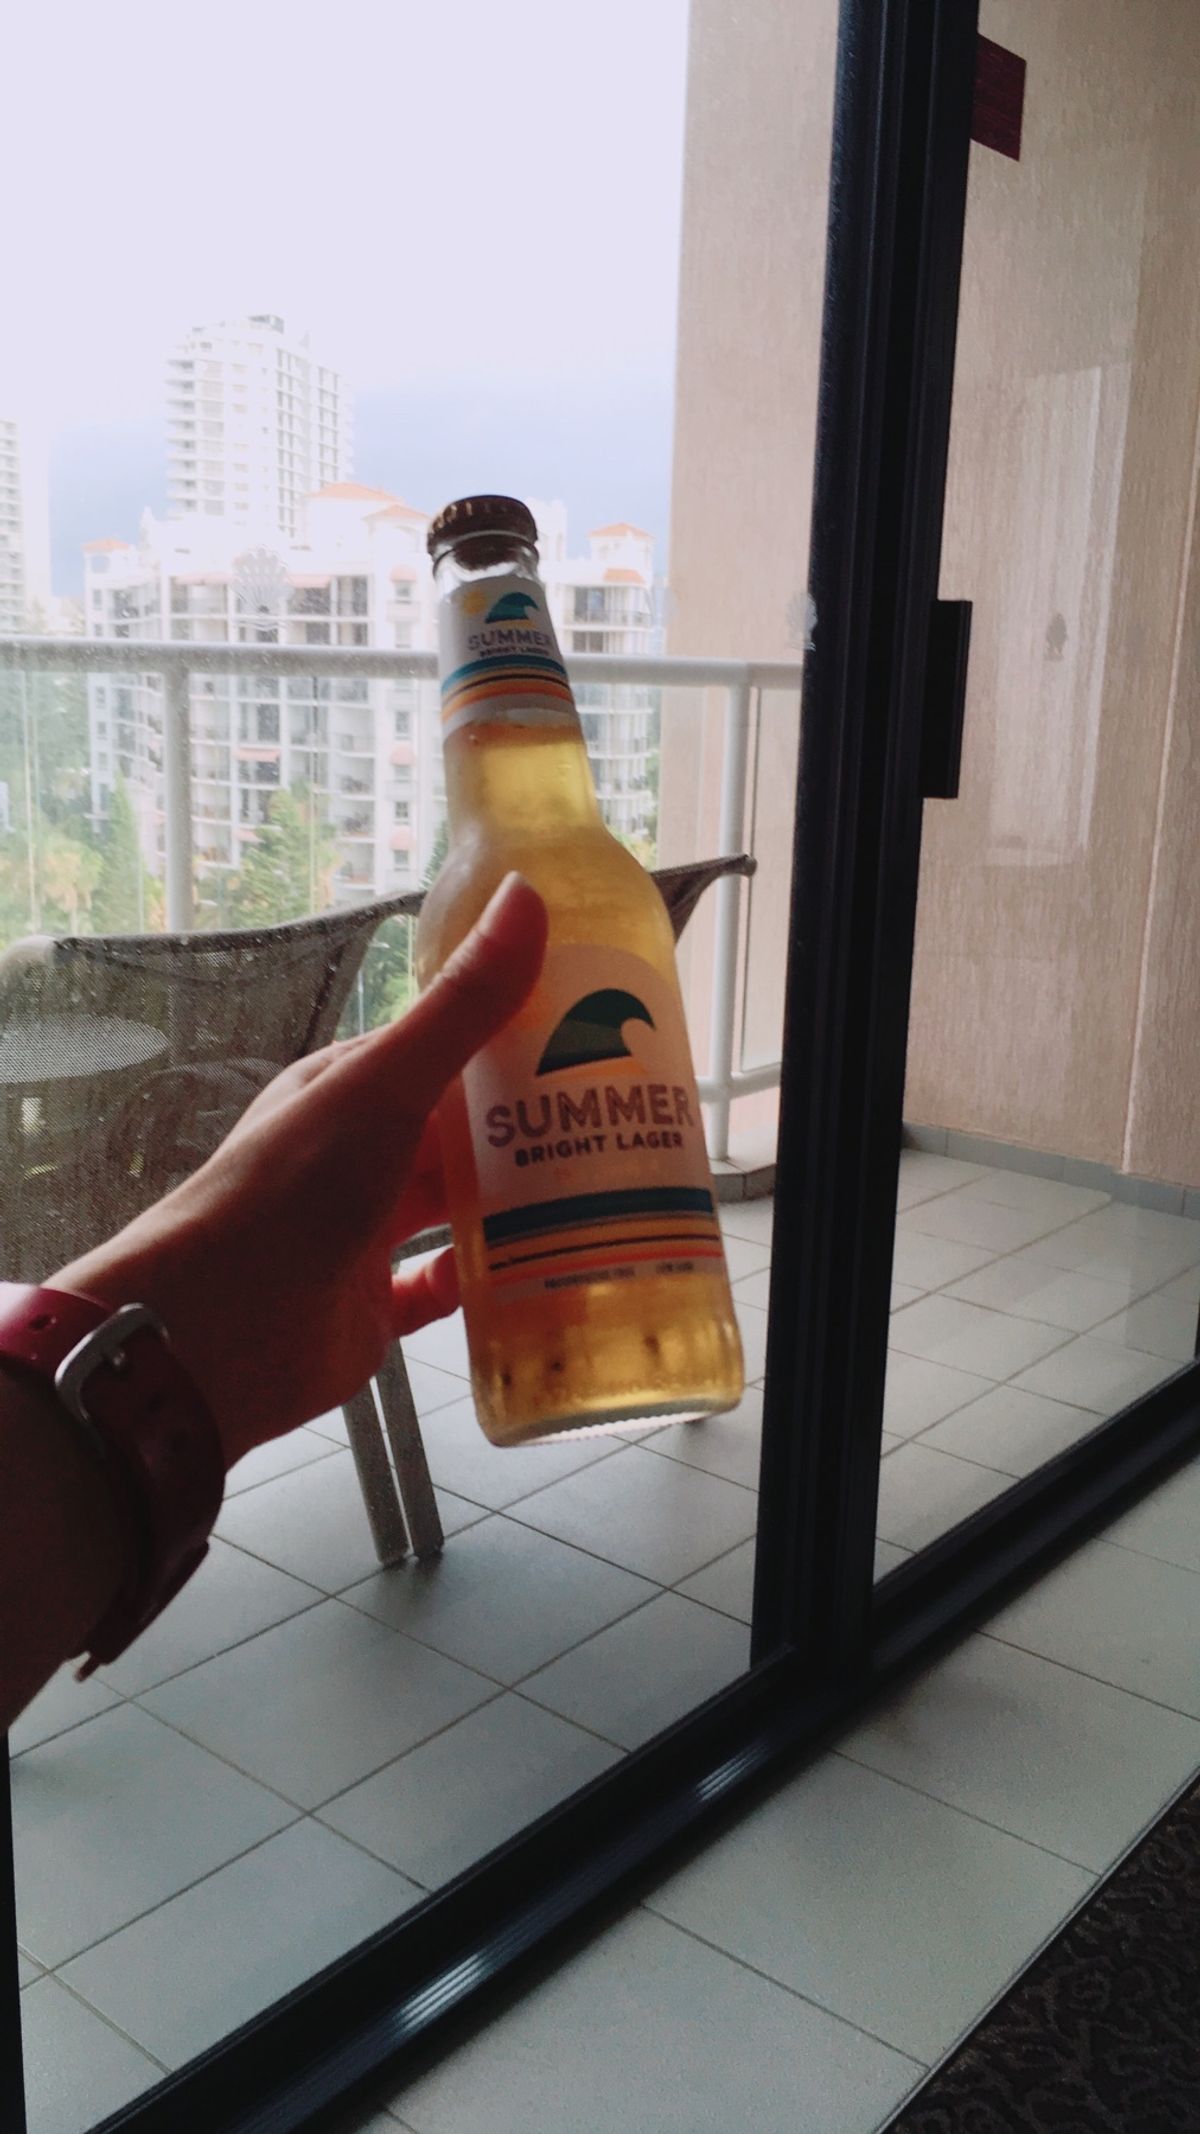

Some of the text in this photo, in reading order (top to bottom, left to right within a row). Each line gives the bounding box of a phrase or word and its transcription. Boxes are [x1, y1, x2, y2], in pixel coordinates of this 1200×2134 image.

[486, 1084, 694, 1148] SUMMER
[514, 1131, 684, 1168] BRIGHT LAGER
